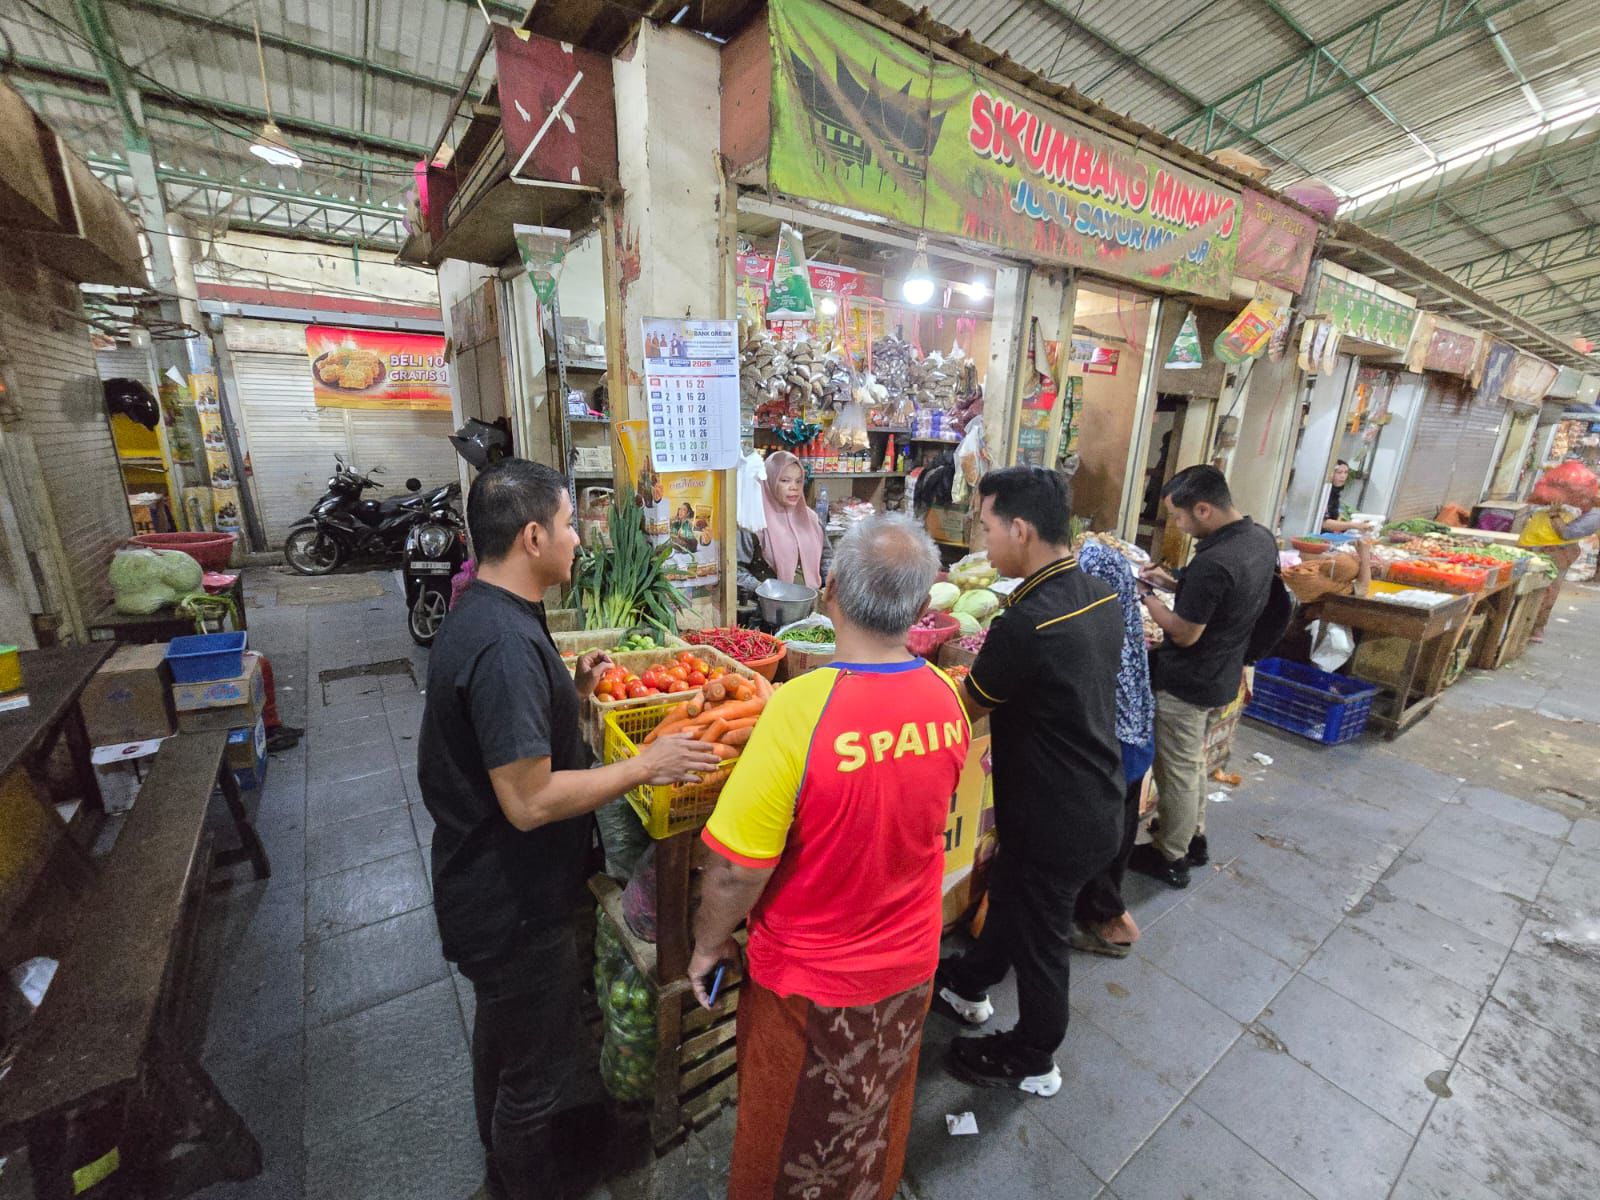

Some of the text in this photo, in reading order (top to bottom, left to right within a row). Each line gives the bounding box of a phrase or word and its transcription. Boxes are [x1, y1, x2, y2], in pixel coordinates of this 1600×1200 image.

[1150, 170, 1236, 239] MINANG
[1075, 201, 1145, 249] SAYUR
[390, 354, 445, 367] BELI 10
[390, 370, 446, 381] GRATIS 1
[686, 380, 693, 388] 15
[697, 380, 705, 388] 22
[697, 392, 706, 400] 23
[688, 405, 694, 413] 17
[698, 405, 706, 413] 24
[699, 417, 707, 425] 25
[678, 430, 685, 438] 12
[700, 429, 707, 437] 26
[701, 441, 707, 449] 27
[834, 719, 963, 773] SPAIN
